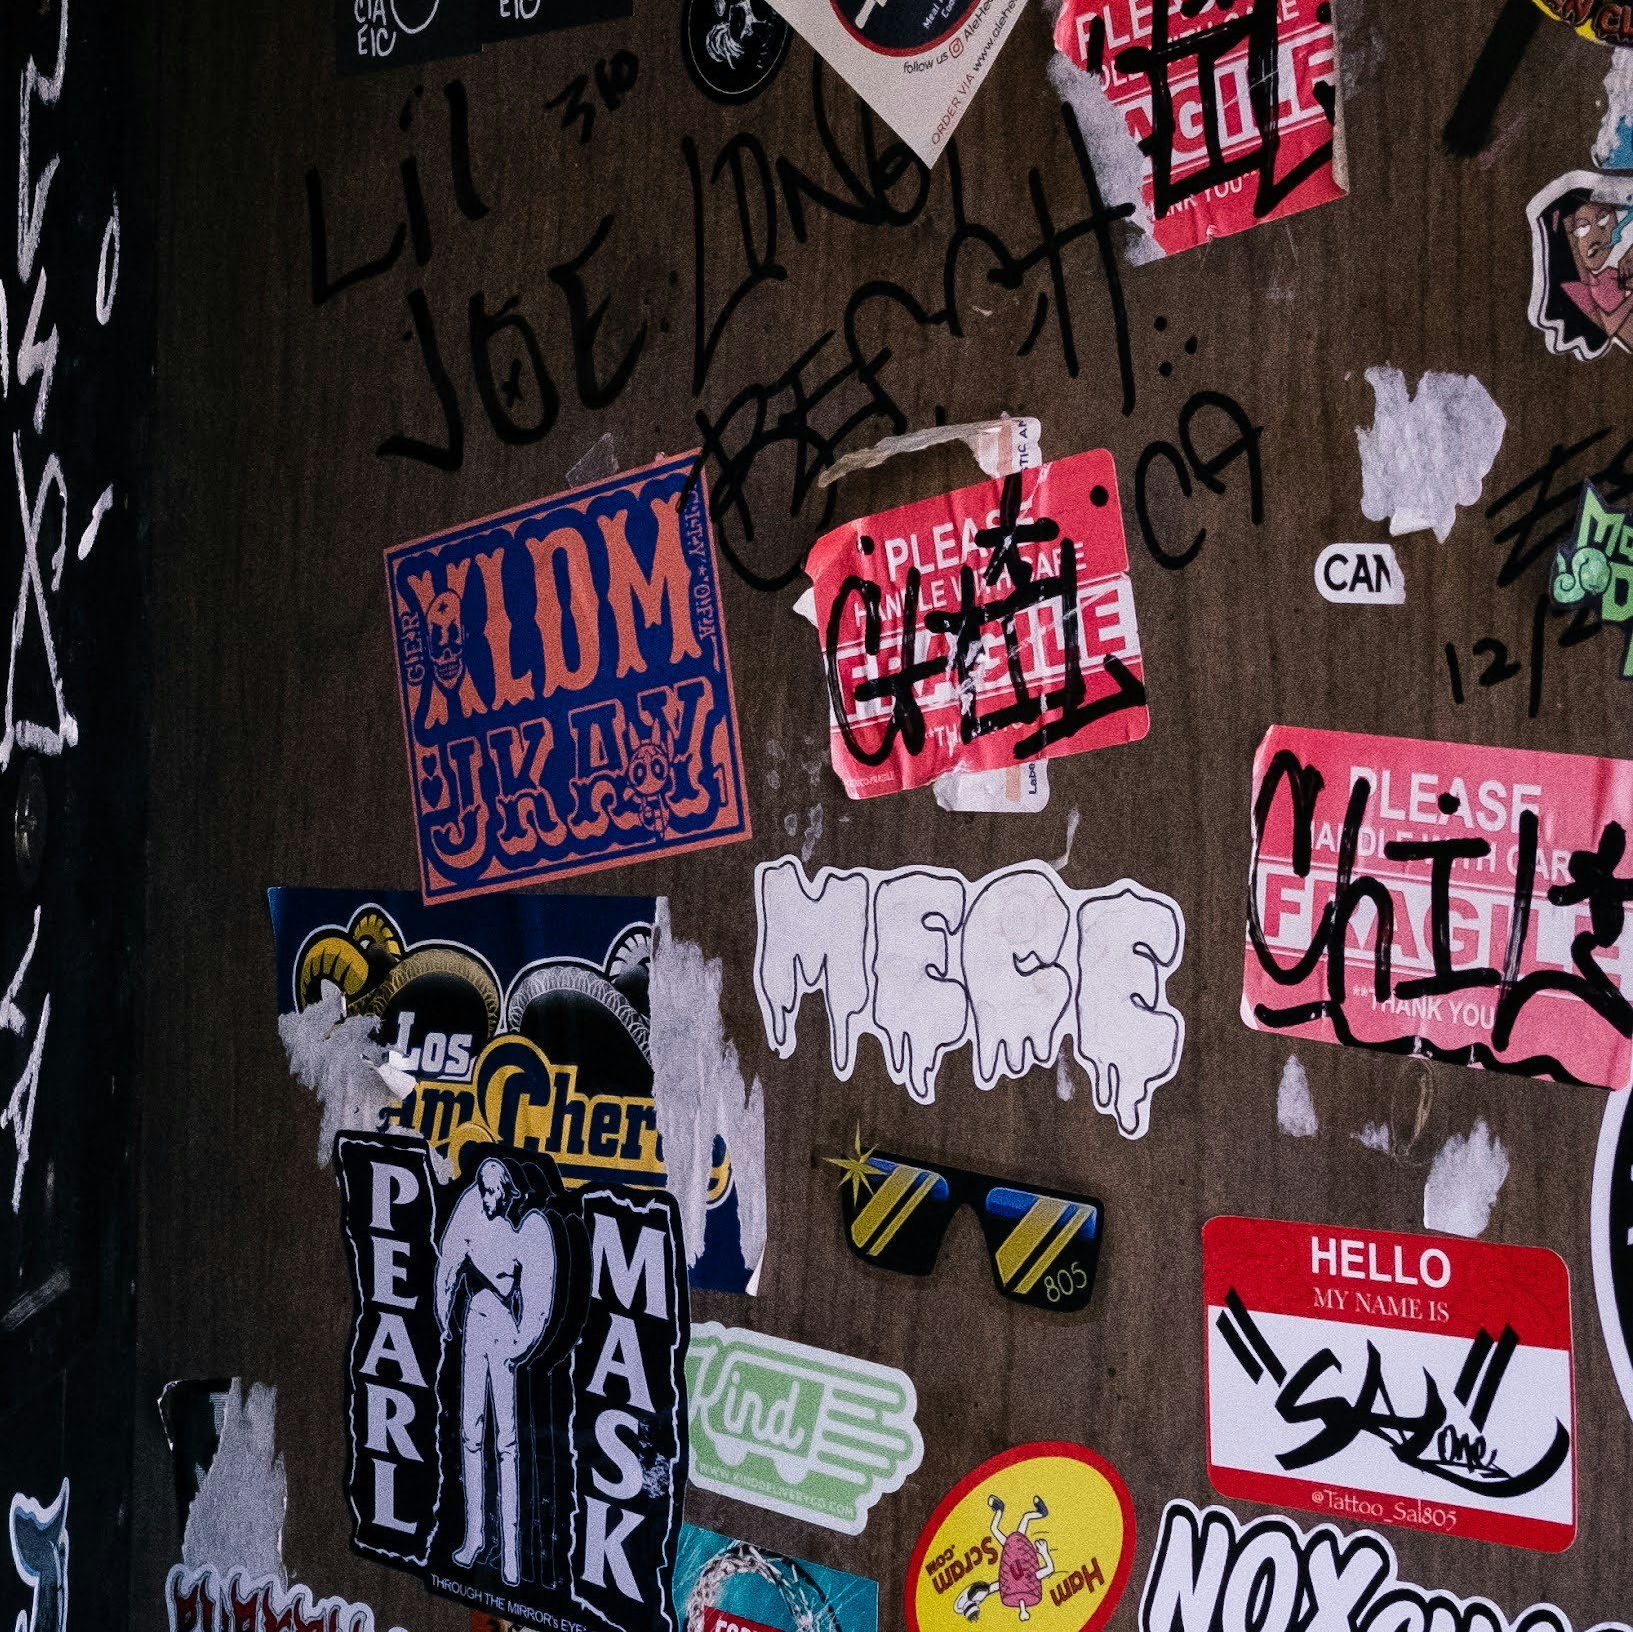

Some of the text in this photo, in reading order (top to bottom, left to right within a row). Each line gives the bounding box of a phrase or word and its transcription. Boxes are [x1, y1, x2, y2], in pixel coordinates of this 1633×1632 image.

[903, 50, 936, 75] follow
[931, 97, 963, 147] ORDER
[1044, 1263, 1088, 1305] 805
[1310, 1237, 1452, 1291] HELLO
[1313, 1288, 1450, 1323] MY NAME IS
[368, 1161, 427, 1538] PEARL
[583, 1215, 672, 1604] MASK
[691, 1353, 806, 1453] Kind
[1310, 1486, 1458, 1530] @Tattoo_Sal805
[429, 1571, 507, 1610] THROUGH THE
[932, 1535, 1105, 1609] Ham Scram
